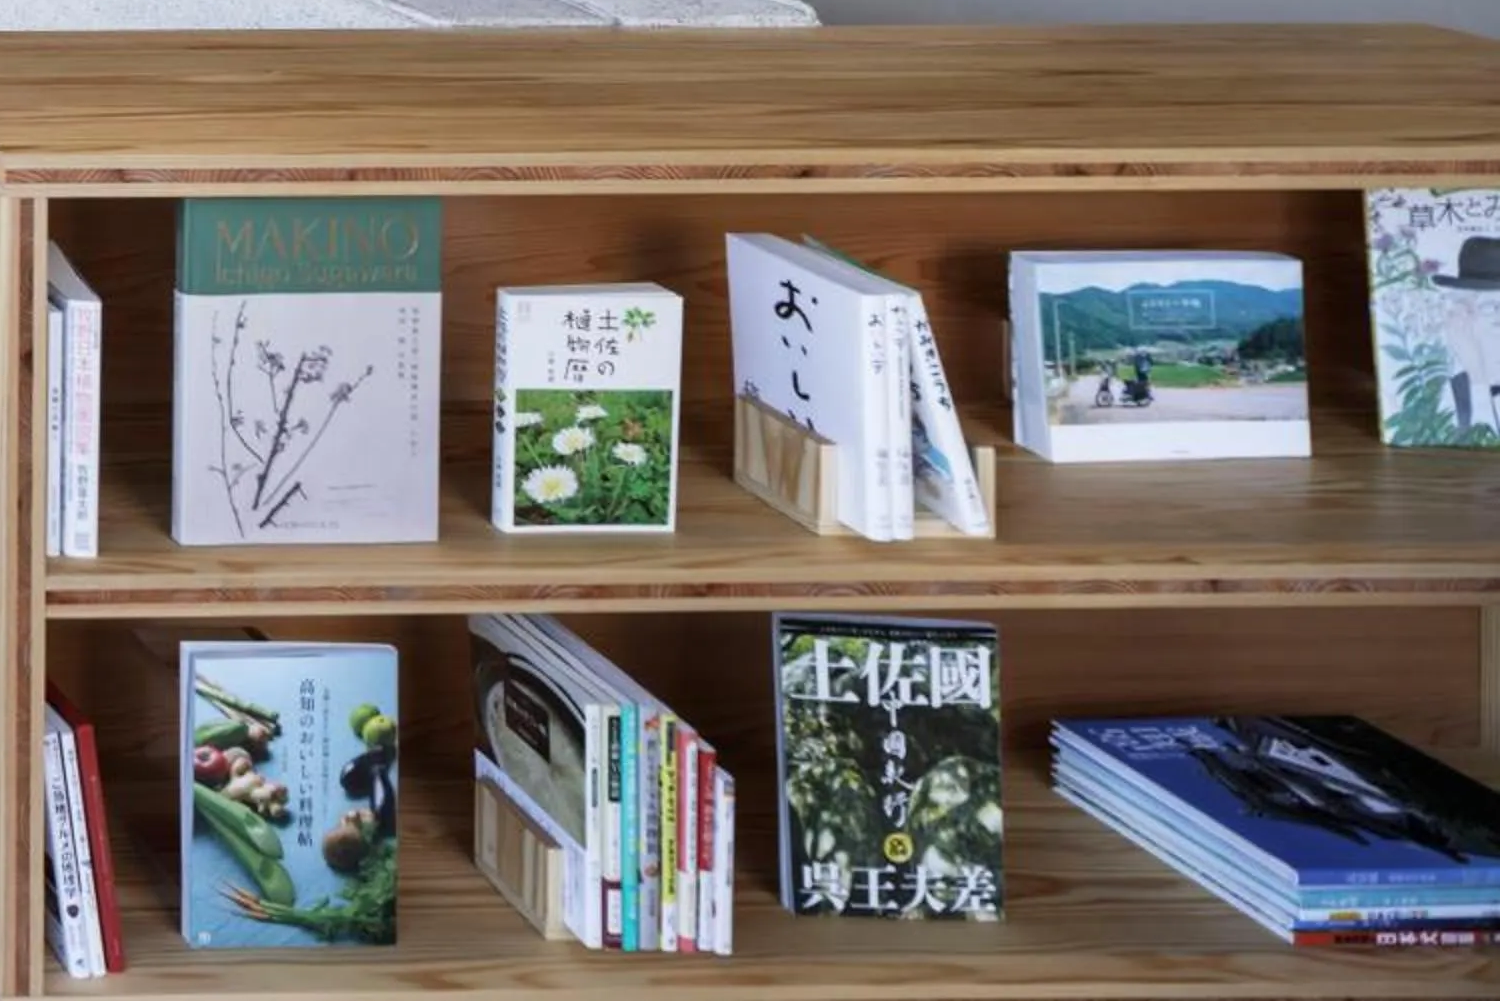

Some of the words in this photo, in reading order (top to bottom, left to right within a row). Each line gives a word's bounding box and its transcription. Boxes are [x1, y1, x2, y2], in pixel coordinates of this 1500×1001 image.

[216, 214, 419, 261] MAKINO
[788, 639, 992, 709] 土佐國
